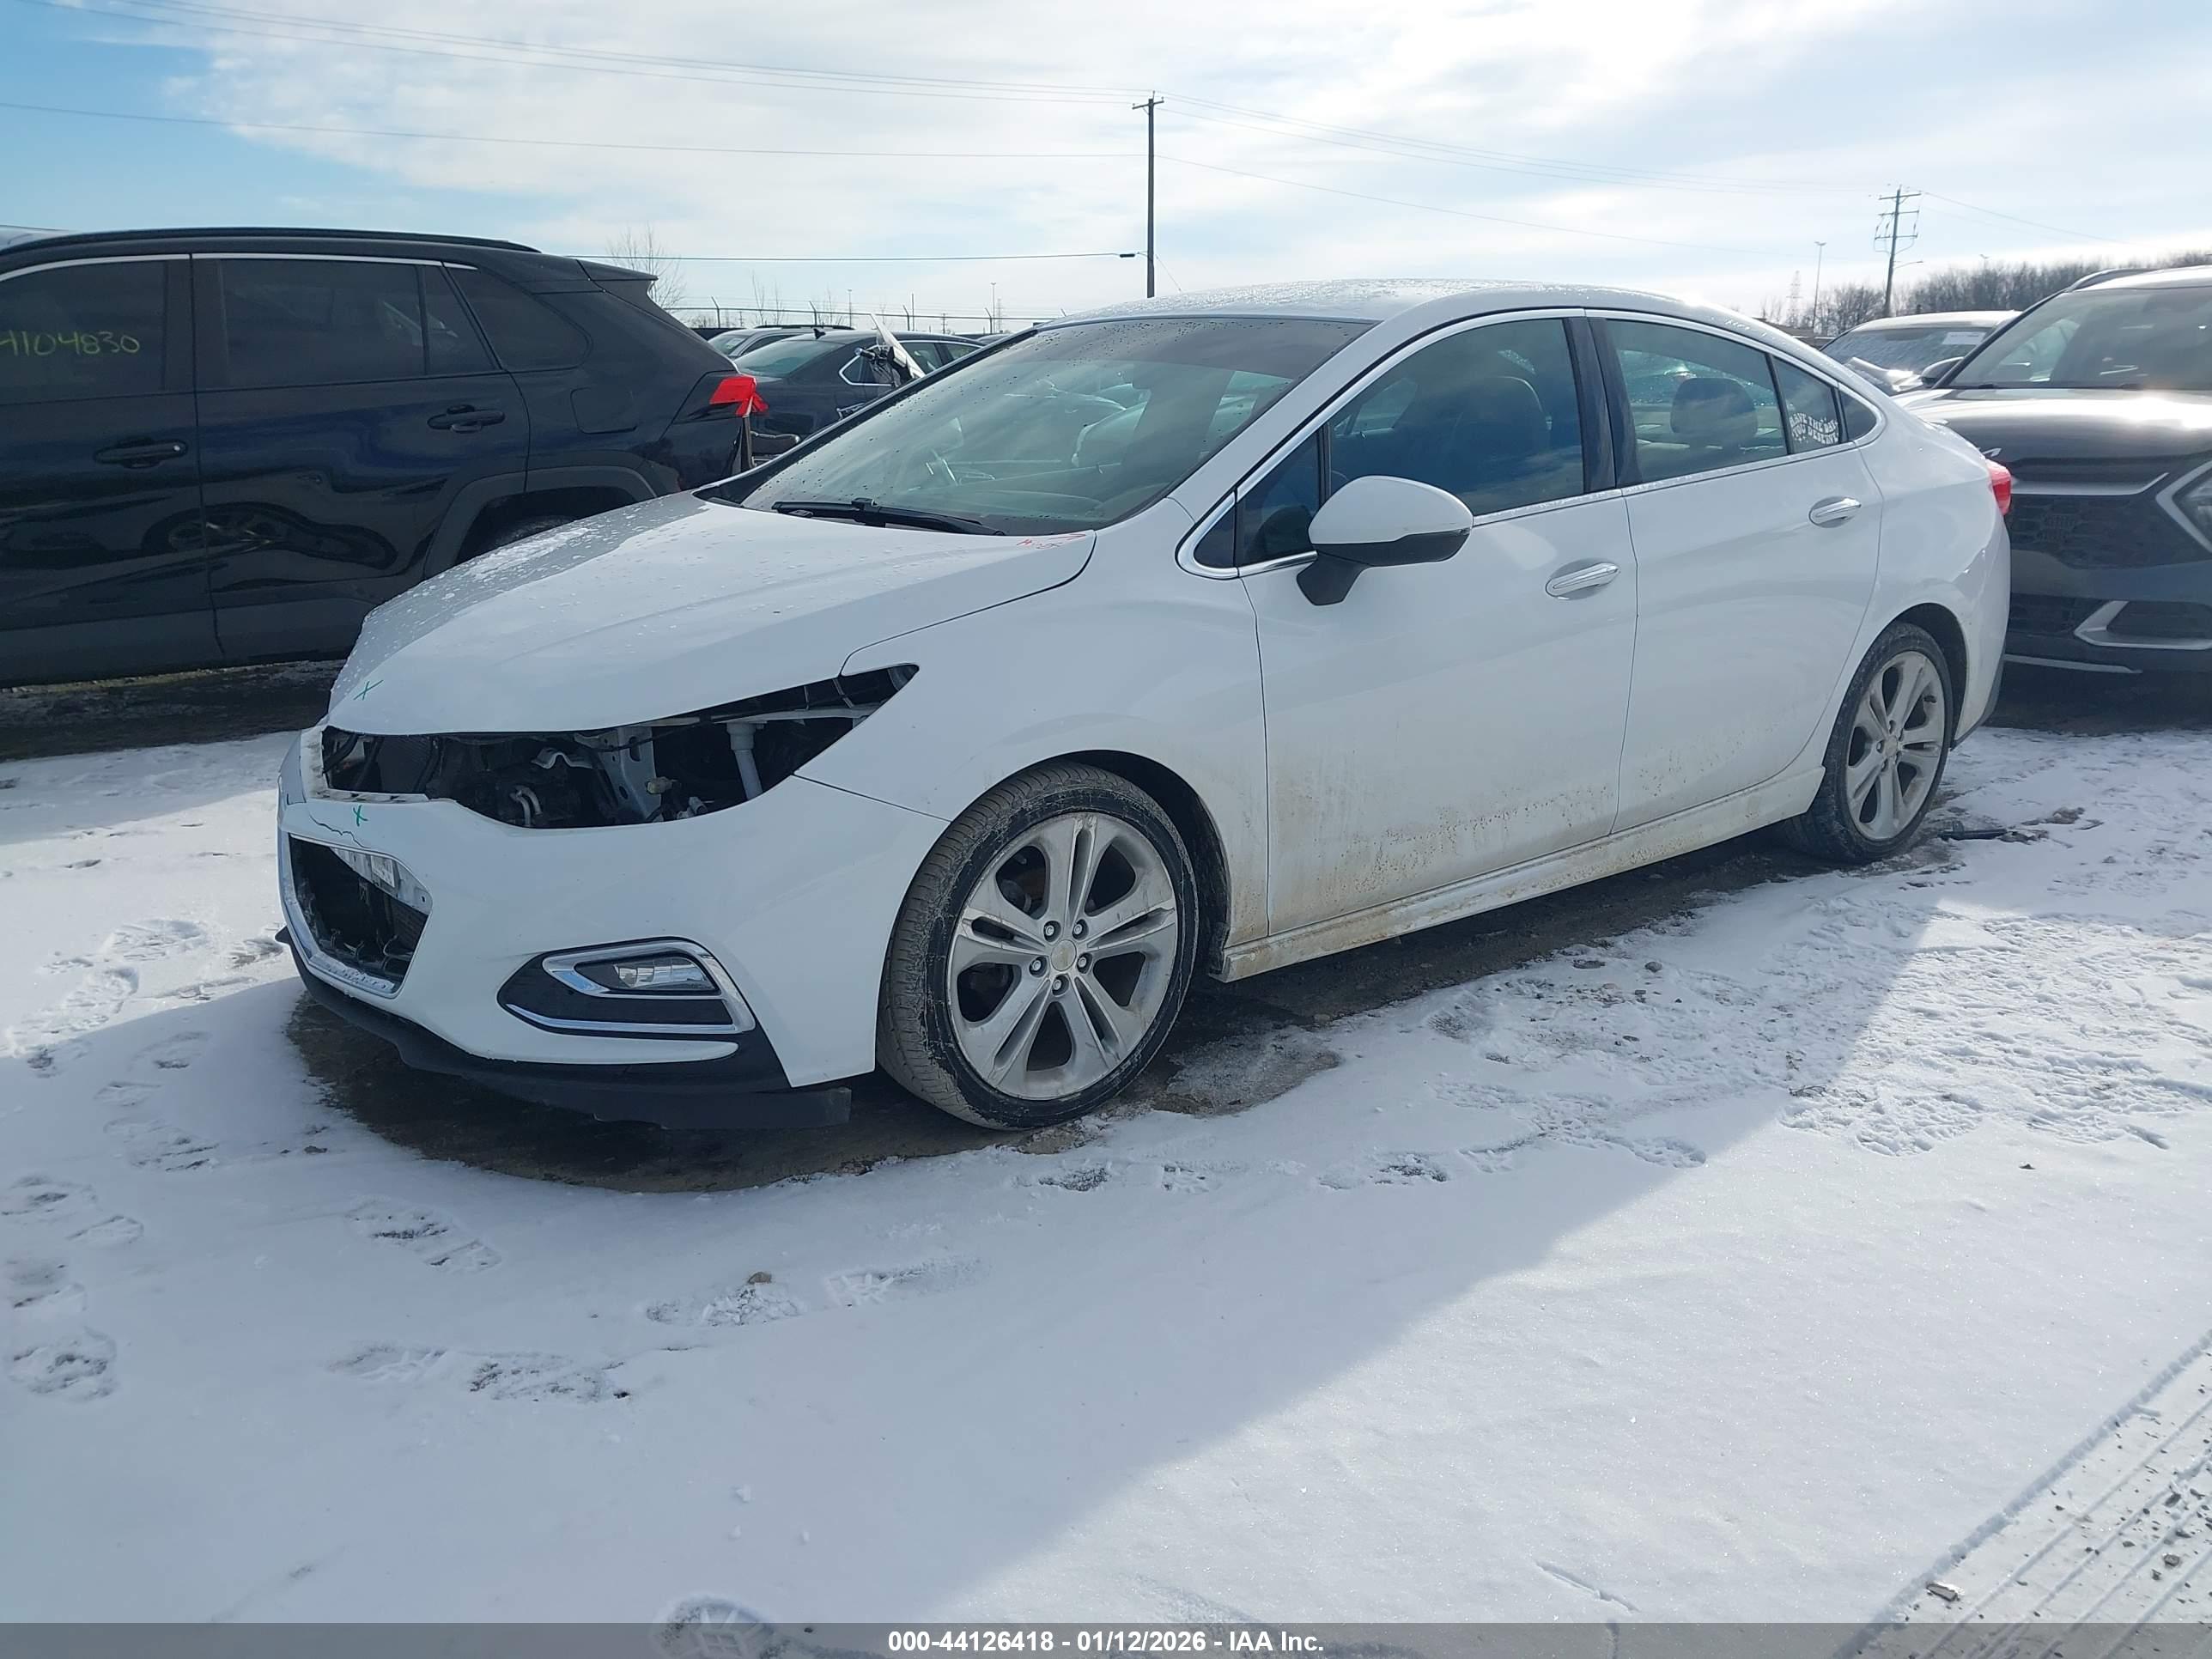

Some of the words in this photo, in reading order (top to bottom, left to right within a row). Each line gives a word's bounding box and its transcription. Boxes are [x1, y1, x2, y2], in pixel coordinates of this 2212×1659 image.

[1789, 413, 1808, 428] HAVE
[1808, 416, 1823, 433] THE
[1823, 419, 1838, 433] DAY
[1792, 424, 1807, 437] YOU
